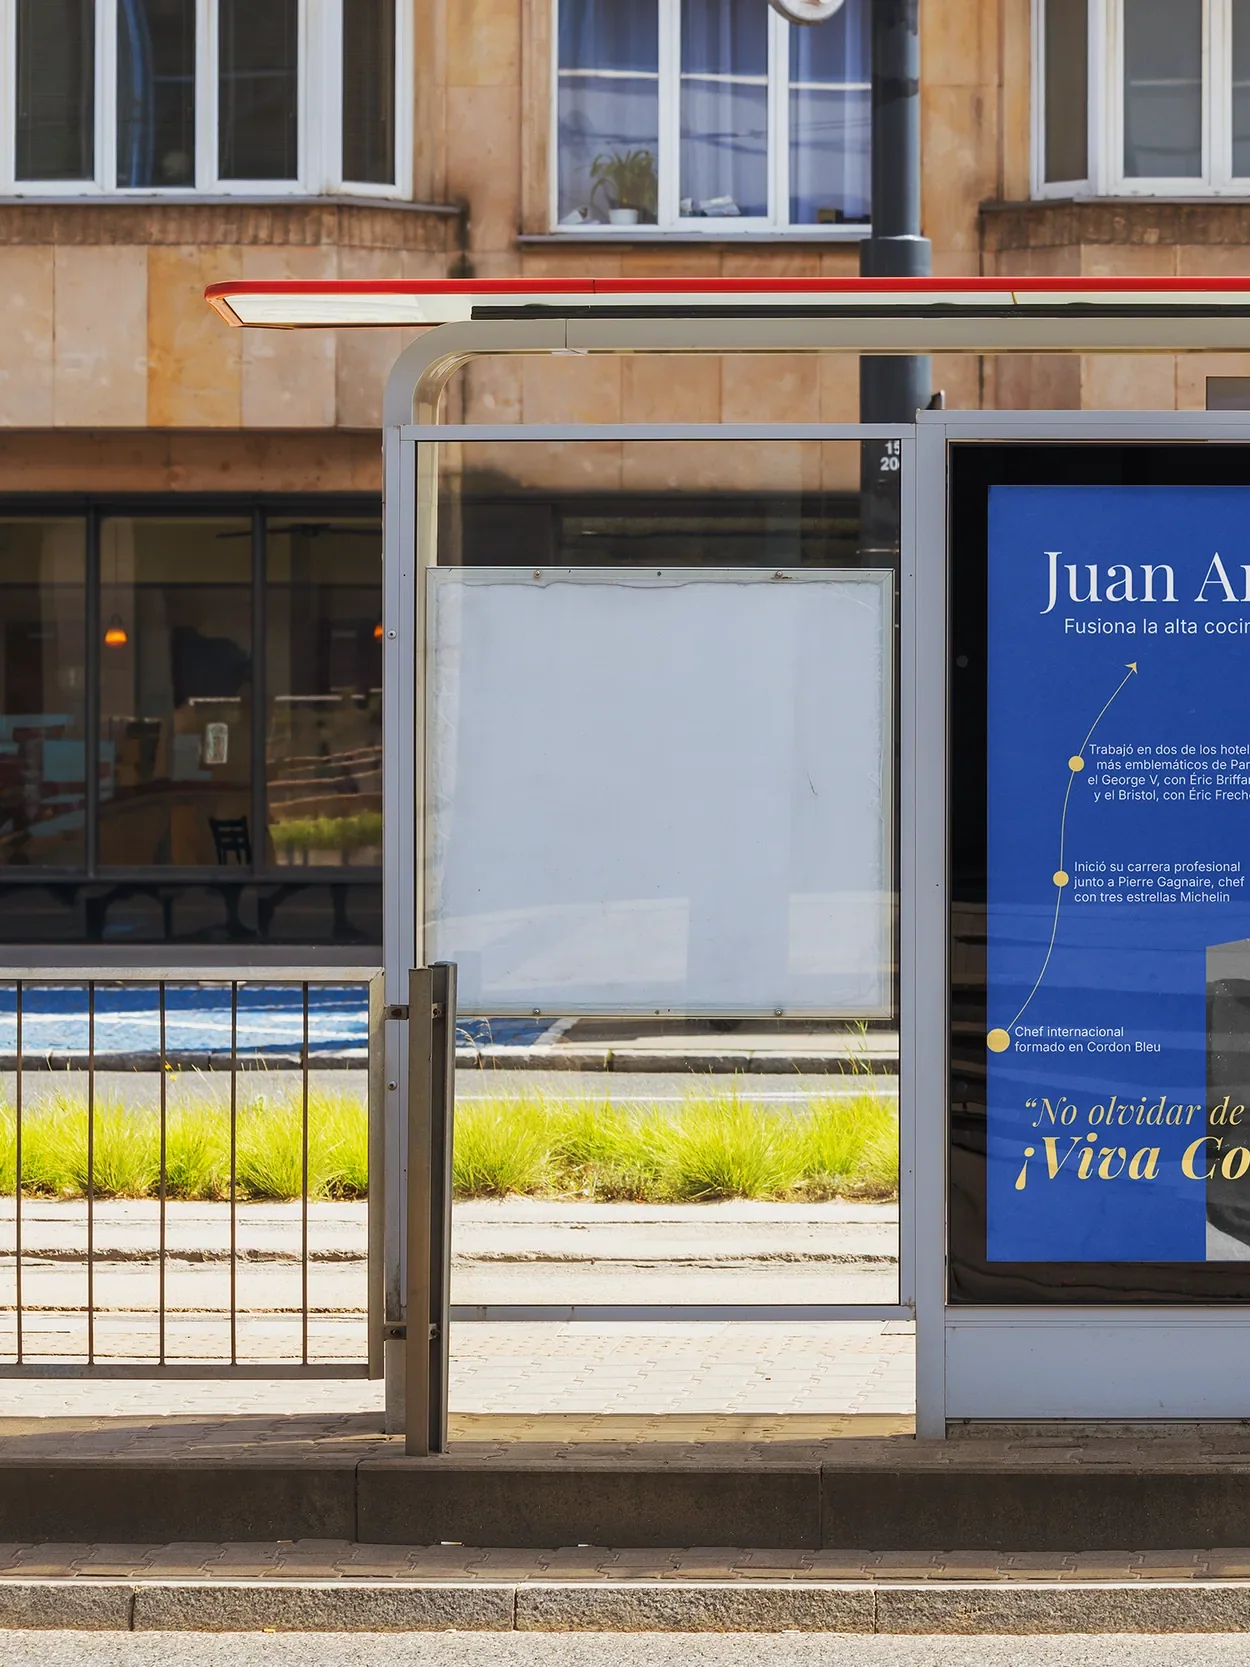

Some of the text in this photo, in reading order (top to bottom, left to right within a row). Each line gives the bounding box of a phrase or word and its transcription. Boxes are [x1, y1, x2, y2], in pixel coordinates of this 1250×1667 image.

[1040, 552, 1178, 614] Juan
[1065, 618, 1135, 634] Fusiona
[1144, 619, 1157, 633] la
[1165, 619, 1197, 633] alta
[1089, 744, 1133, 757] Trabajó
[1136, 746, 1152, 755] en
[1155, 744, 1178, 755] dos
[1180, 744, 1196, 755] de
[1199, 744, 1217, 755] los
[1096, 758, 1122, 771] más
[1124, 758, 1209, 771] emblemáticos
[1211, 759, 1227, 770] de
[1087, 774, 1098, 786] el
[1101, 774, 1146, 788] George
[1149, 774, 1160, 787] V,
[1163, 776, 1186, 786] con
[1190, 772, 1212, 786] Éric
[1093, 791, 1101, 803] y
[1104, 789, 1115, 801] el
[1118, 789, 1159, 802] Bristol,
[1162, 791, 1185, 801] con
[1190, 787, 1211, 801] Éric
[1074, 860, 1240, 874] Inició su carrera profesional
[1073, 875, 1245, 890] junto a Pierre Gagnaire, chef
[1074, 891, 1230, 903] con tres estrellas Michelin
[1014, 1025, 1124, 1038] Chef internacional
[1014, 1040, 1161, 1053] formado en Cordon Bleu
[1025, 1097, 1077, 1127] “No
[1088, 1095, 1201, 1126] olvidar
[1209, 1095, 1245, 1126] de
[1015, 1132, 1161, 1190] ¡Viva
